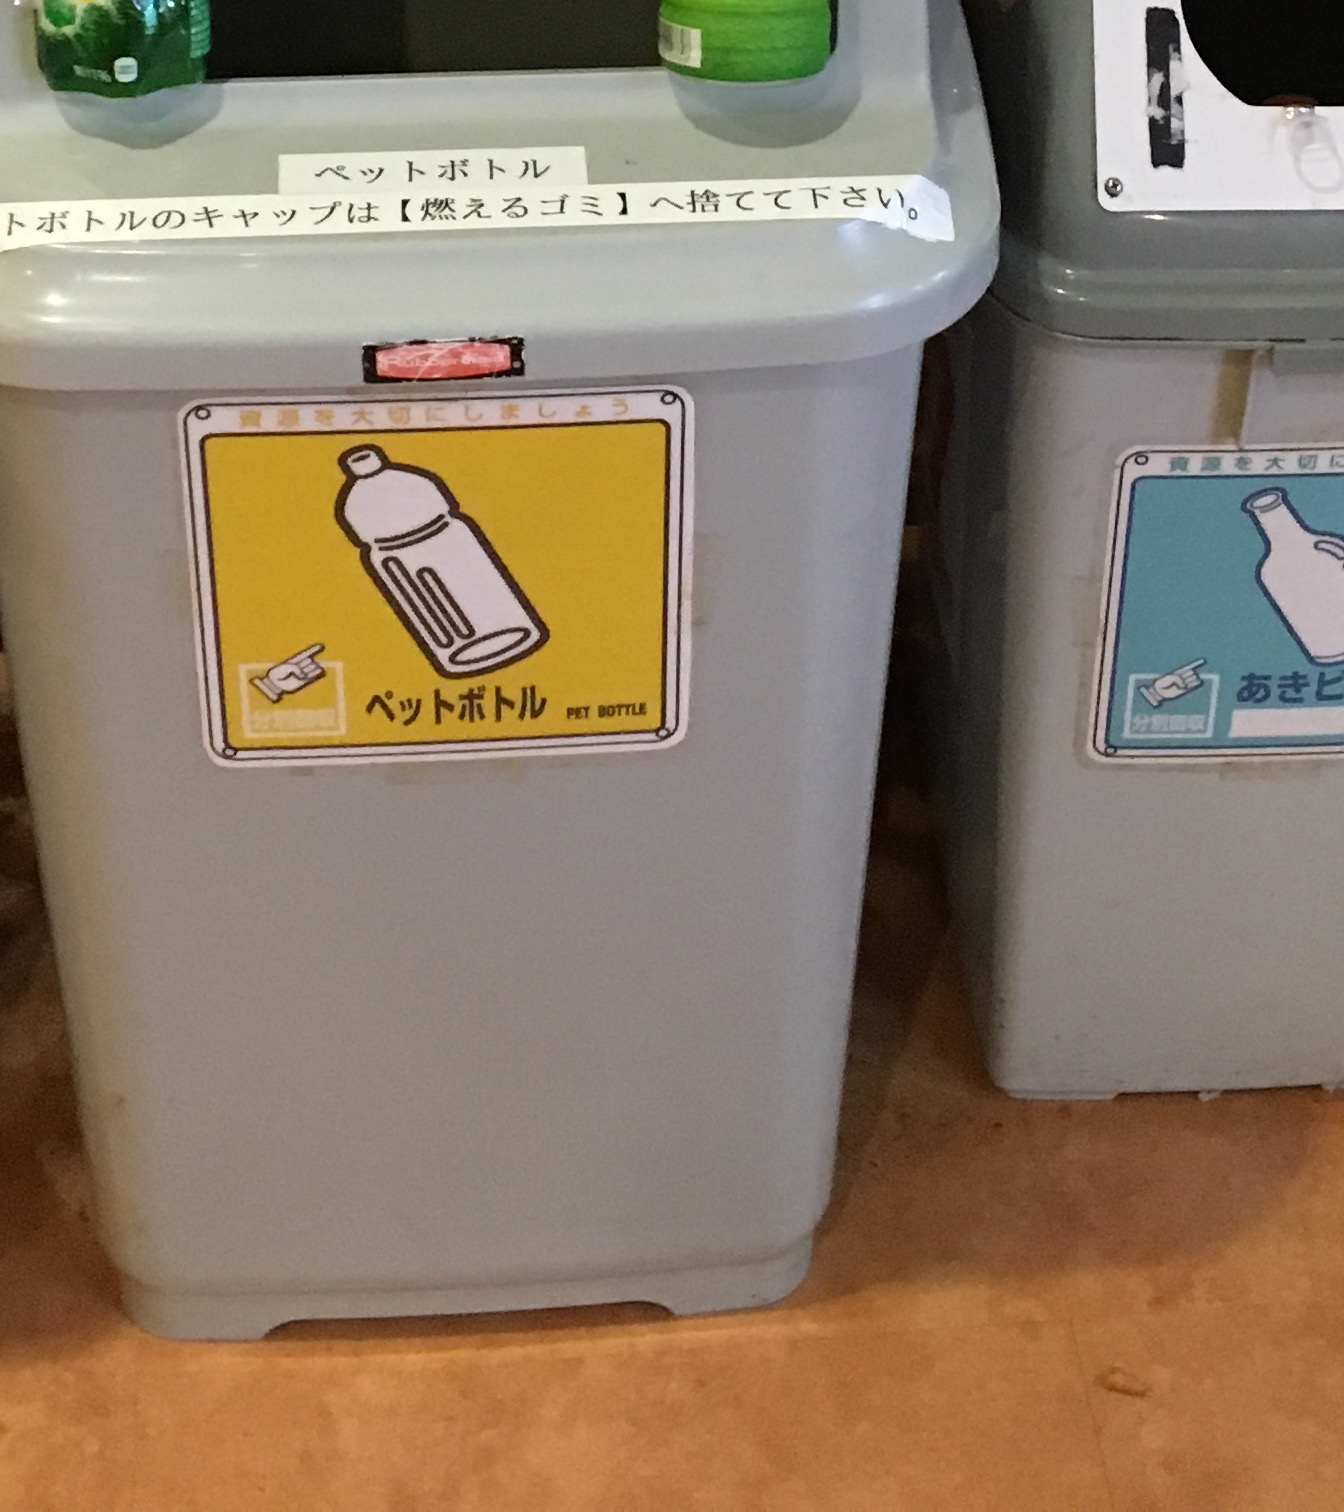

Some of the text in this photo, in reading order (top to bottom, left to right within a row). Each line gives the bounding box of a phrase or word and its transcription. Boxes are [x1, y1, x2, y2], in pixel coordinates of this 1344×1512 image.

[316, 155, 552, 185] ペットボトル
[364, 686, 547, 725] ペットボトル
[566, 702, 647, 719] PET BOTTLE
